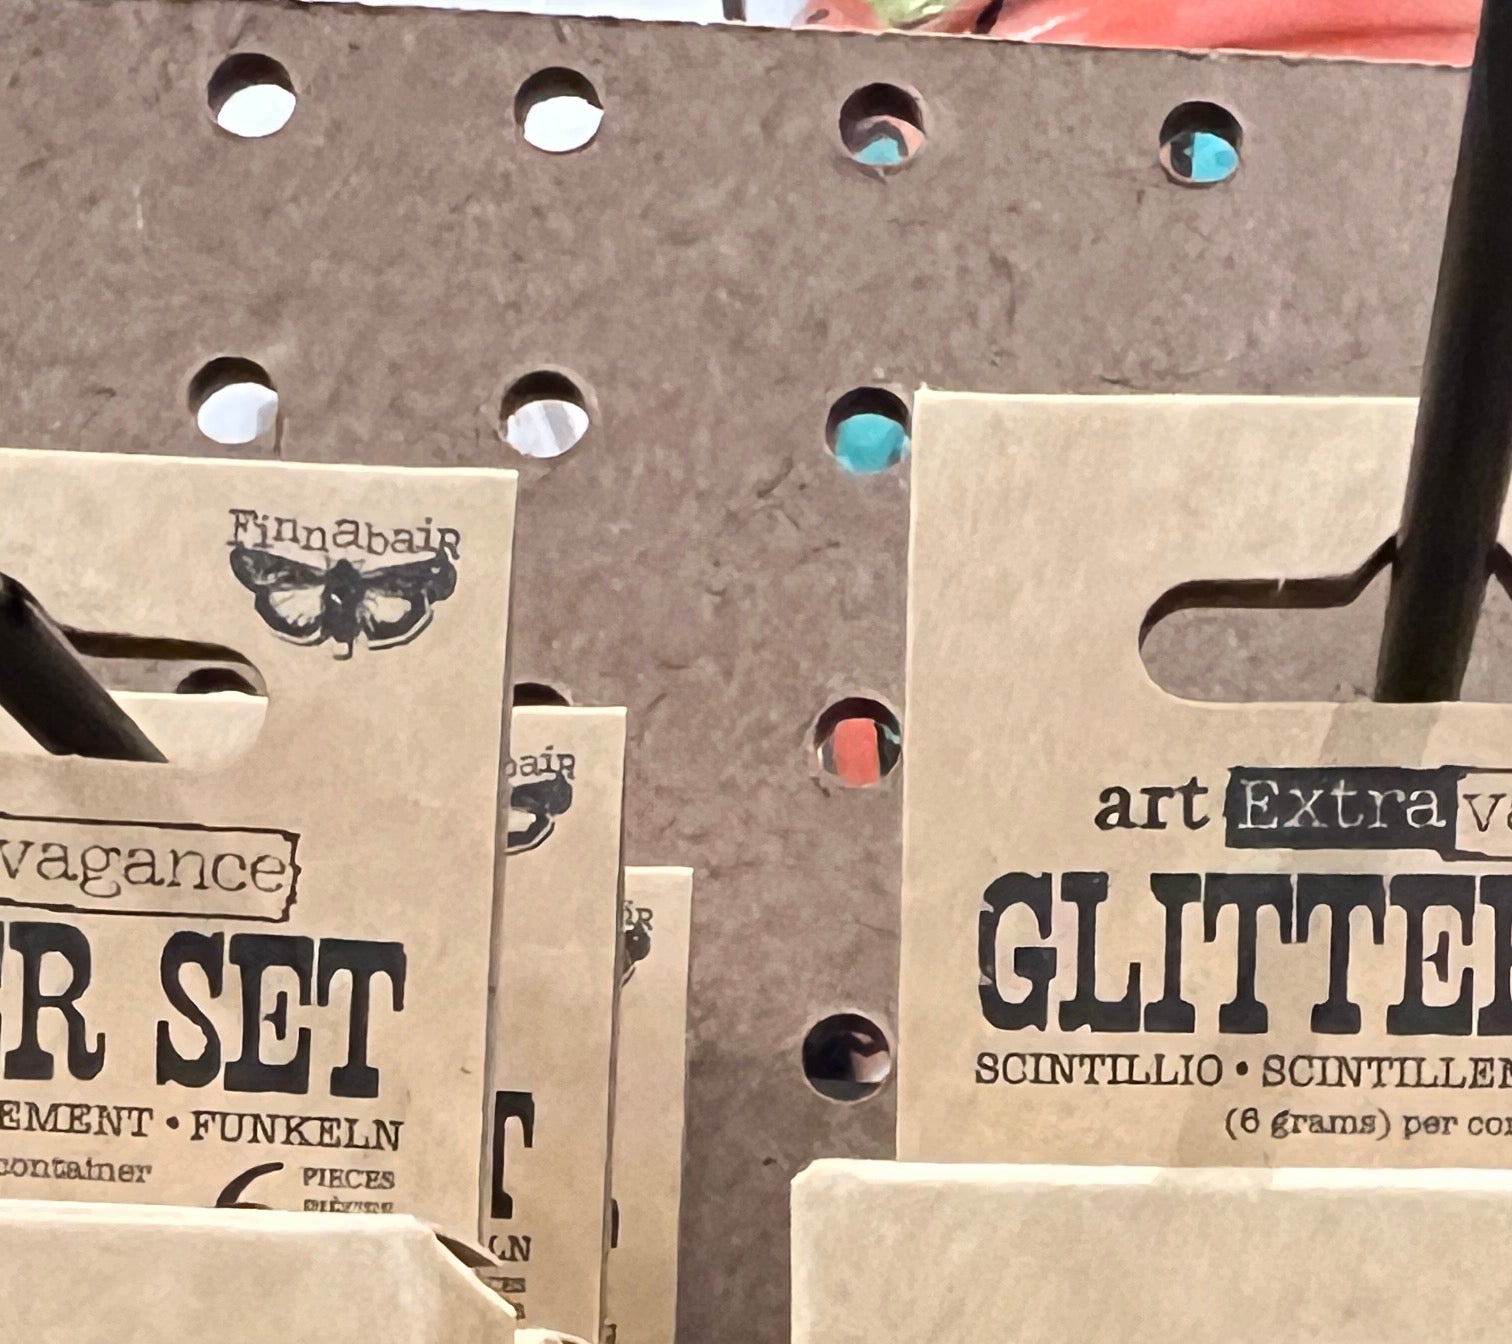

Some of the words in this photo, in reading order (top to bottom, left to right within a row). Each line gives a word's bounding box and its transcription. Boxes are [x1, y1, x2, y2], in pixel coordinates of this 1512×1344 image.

[1094, 776, 1210, 831] art
[0, 921, 106, 1081] R
[156, 930, 407, 1099] SET
[975, 1052, 1224, 1086] SCINTILLIO
[190, 1110, 404, 1151] FUNKELN
[1271, 1108, 1392, 1140] grams)
[1403, 1114, 1458, 1140] per
[302, 1166, 395, 1190] PIECES
